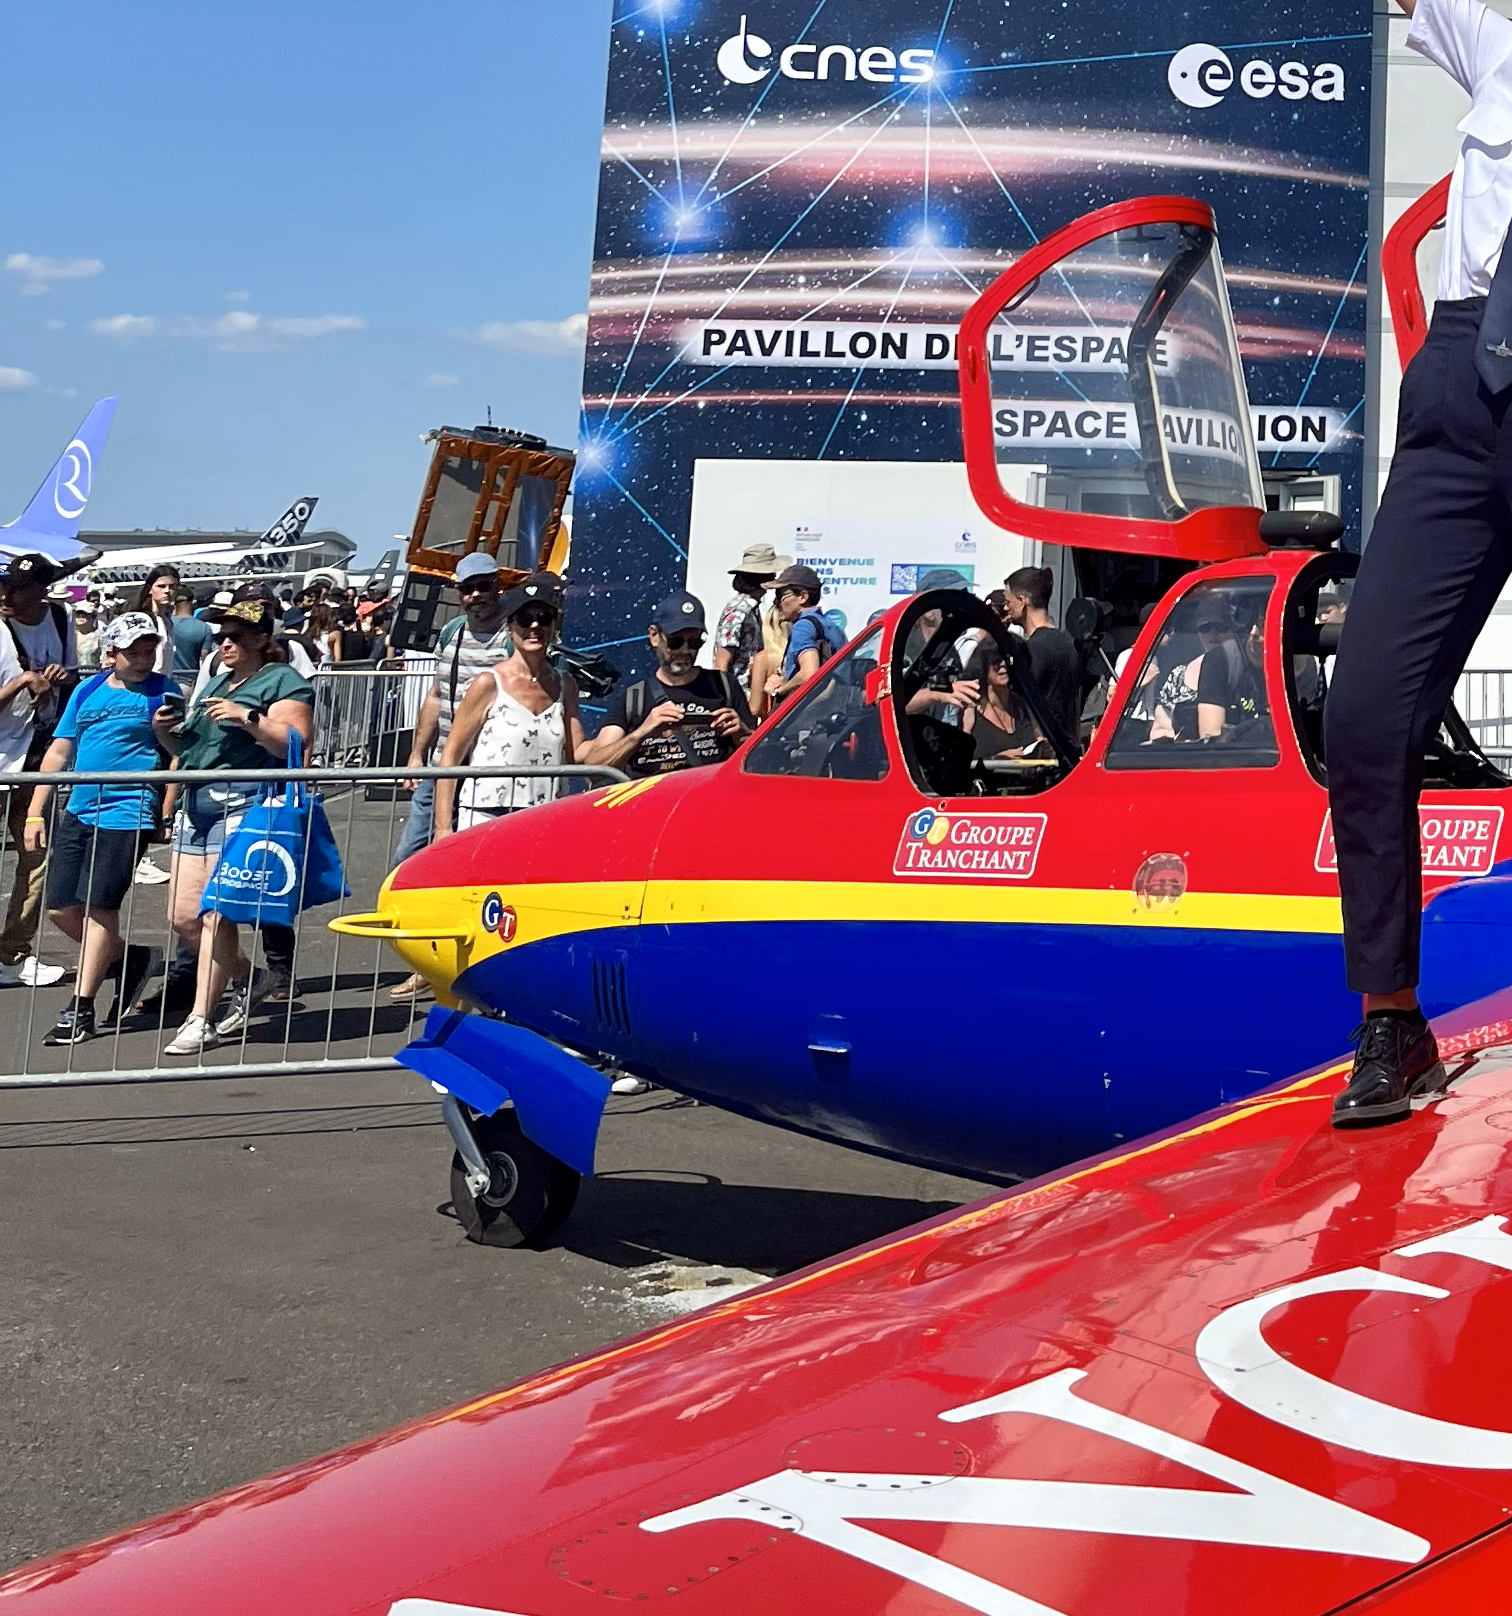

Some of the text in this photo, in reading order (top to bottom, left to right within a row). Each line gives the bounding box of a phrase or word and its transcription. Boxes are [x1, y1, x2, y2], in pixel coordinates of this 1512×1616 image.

[780, 43, 935, 83] cnes
[1240, 59, 1345, 102] esa
[702, 328, 1168, 368] PAVILLON D L'ESPAE
[994, 409, 1127, 439] SPACE
[270, 502, 310, 547] 350
[950, 819, 1036, 845] GROUPE
[1422, 819, 1491, 841] OUPE
[905, 841, 1030, 870] TRANCHANT
